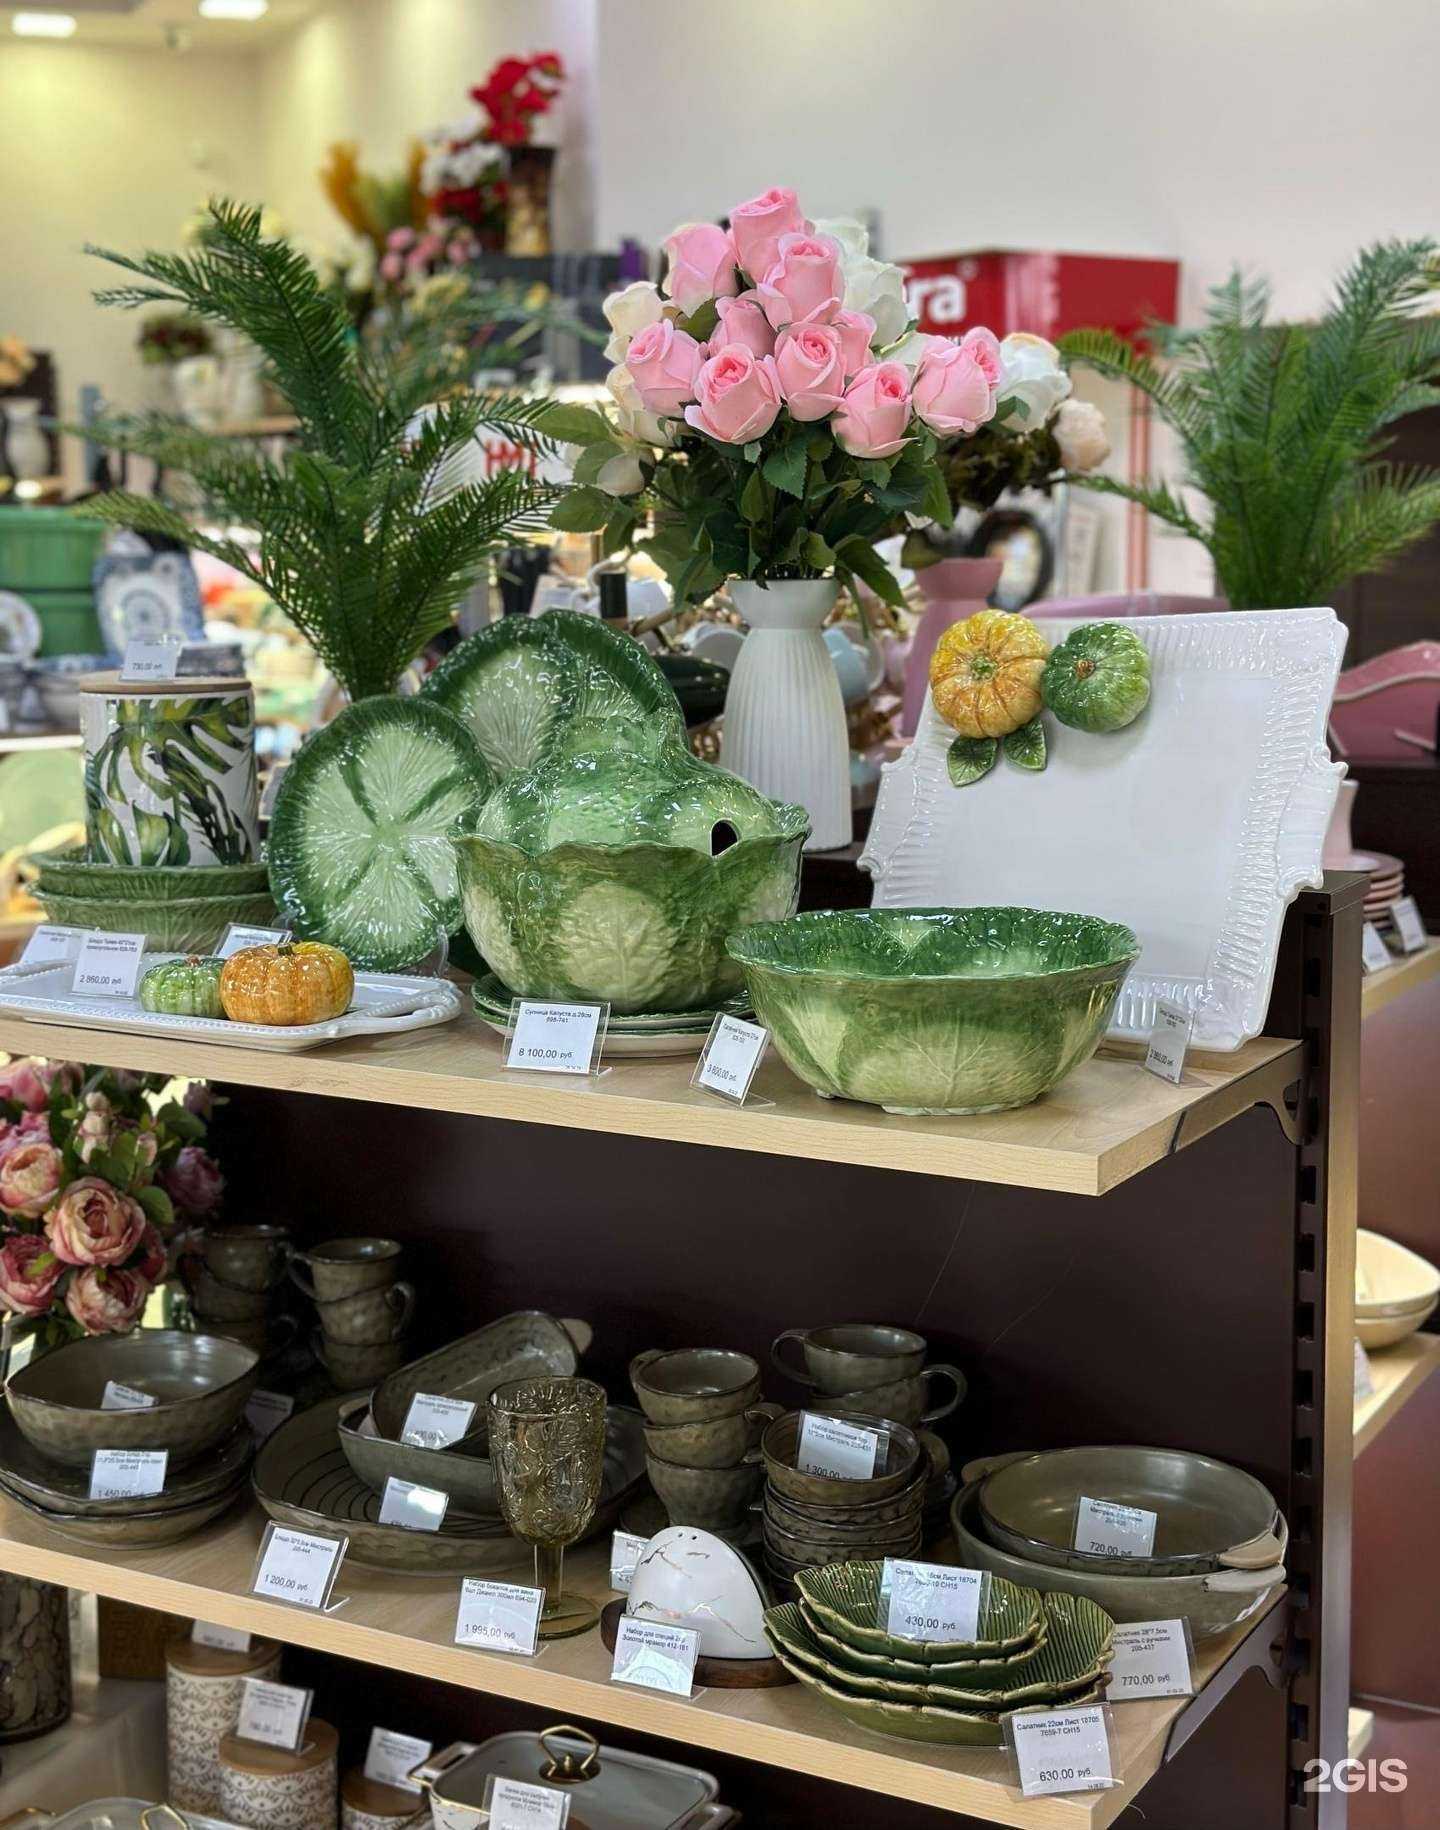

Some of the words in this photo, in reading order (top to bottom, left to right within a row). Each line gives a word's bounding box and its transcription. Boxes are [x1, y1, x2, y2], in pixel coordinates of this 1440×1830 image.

[549, 1009, 571, 1018] Капуста
[518, 1048, 524, 1056] 8
[527, 1049, 557, 1059] 100,00
[1089, 1542, 1118, 1555] 720,00
[265, 1574, 269, 1582] 1
[269, 1576, 296, 1589] 200,00
[959, 1576, 977, 1584] 18704
[486, 1583, 508, 1591] бокалов
[905, 1616, 939, 1629] 430,00
[465, 1624, 469, 1632] 1
[472, 1624, 501, 1638] 995,00
[626, 1627, 643, 1637] Набор
[643, 1630, 654, 1638] для
[622, 1634, 645, 1645] Золотой
[645, 1637, 666, 1649] мрамор
[1121, 1674, 1154, 1686] 770,00
[1016, 1723, 1046, 1731] Салатник
[1047, 1720, 1064, 1728] 22см
[1065, 1718, 1080, 1726] Лист
[1039, 1768, 1074, 1782] 630,00
